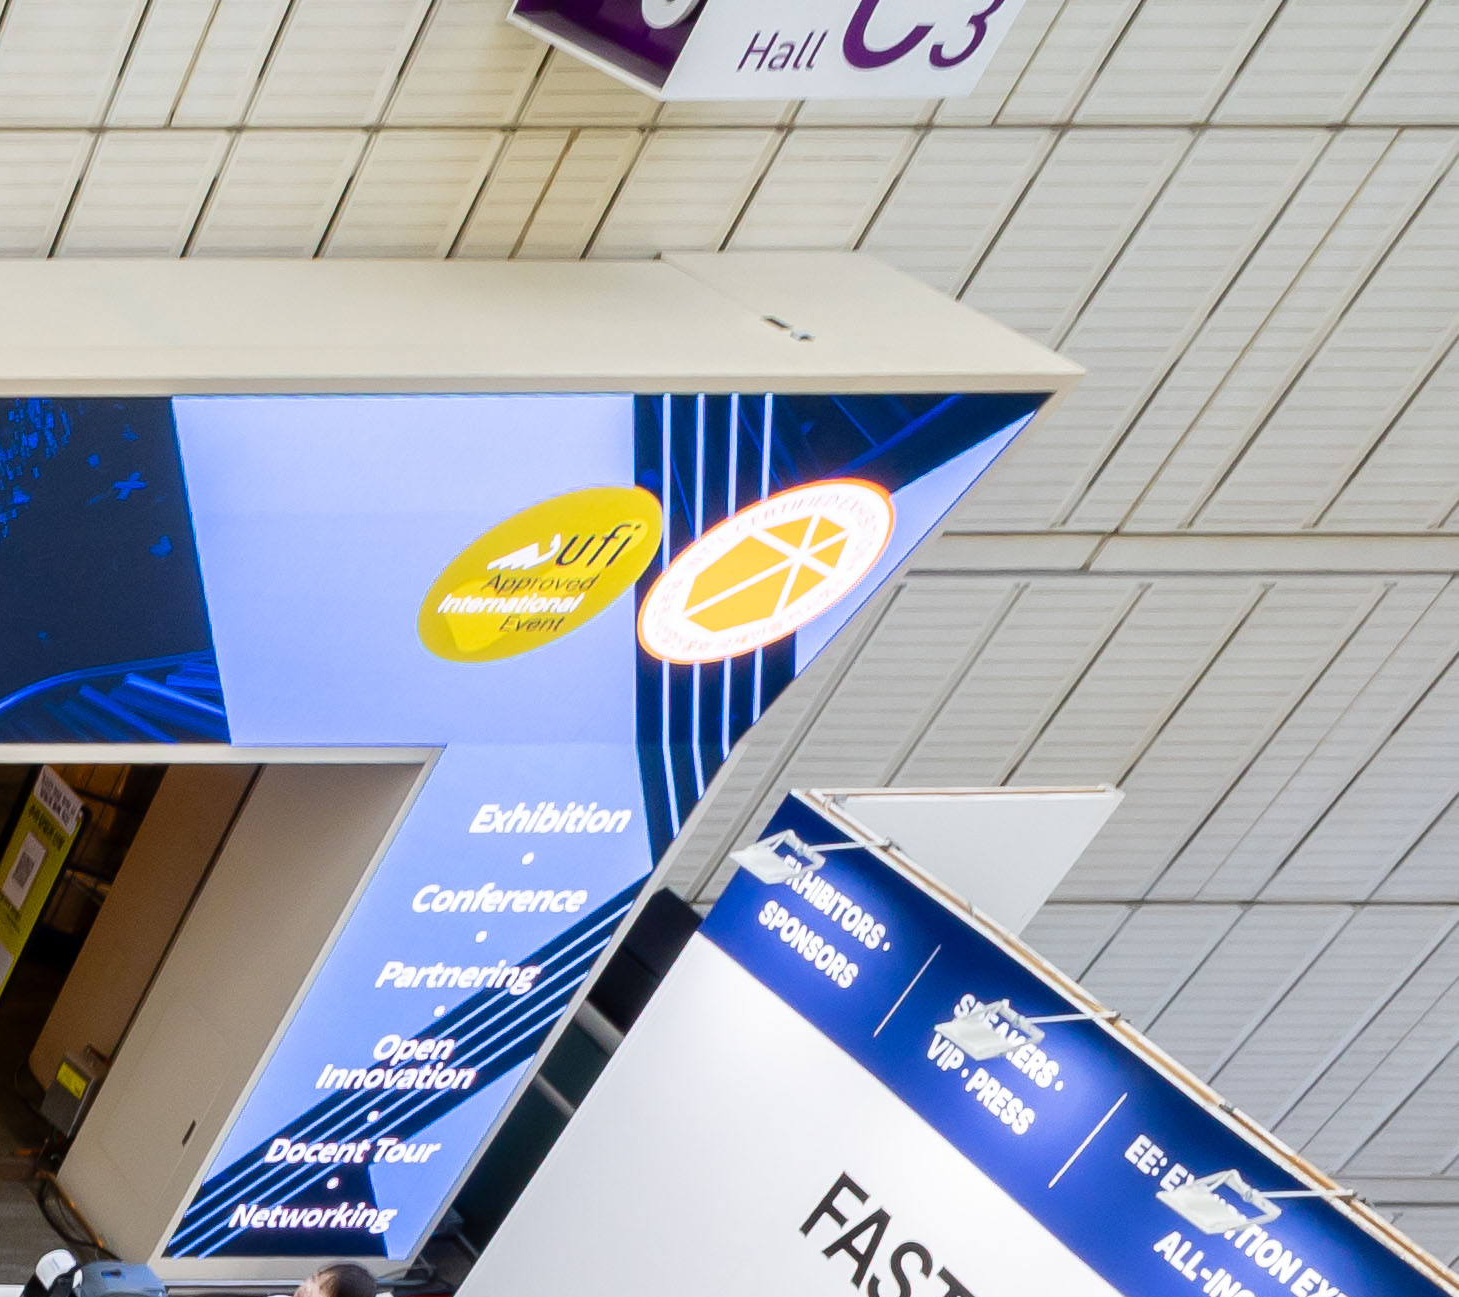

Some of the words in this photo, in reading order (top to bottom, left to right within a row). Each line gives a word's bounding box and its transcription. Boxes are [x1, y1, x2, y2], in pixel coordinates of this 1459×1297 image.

[737, 30, 827, 72] Hall
[555, 523, 643, 568] ufi
[480, 572, 600, 595] Approved
[437, 593, 585, 614] International
[499, 616, 565, 632] Event
[468, 802, 632, 834] Exhibition
[412, 884, 588, 914] Conference
[758, 901, 858, 989] SPONSORS
[374, 960, 541, 996] Partnering
[373, 1034, 455, 1067] Open
[315, 1064, 476, 1090] Innovation
[926, 1033, 960, 1072] VIP
[967, 1070, 1035, 1136] PRESS
[264, 1138, 370, 1164] Docent
[370, 1138, 441, 1164] Tour
[1125, 1134, 1168, 1177] EE:
[228, 1203, 397, 1234] Networking
